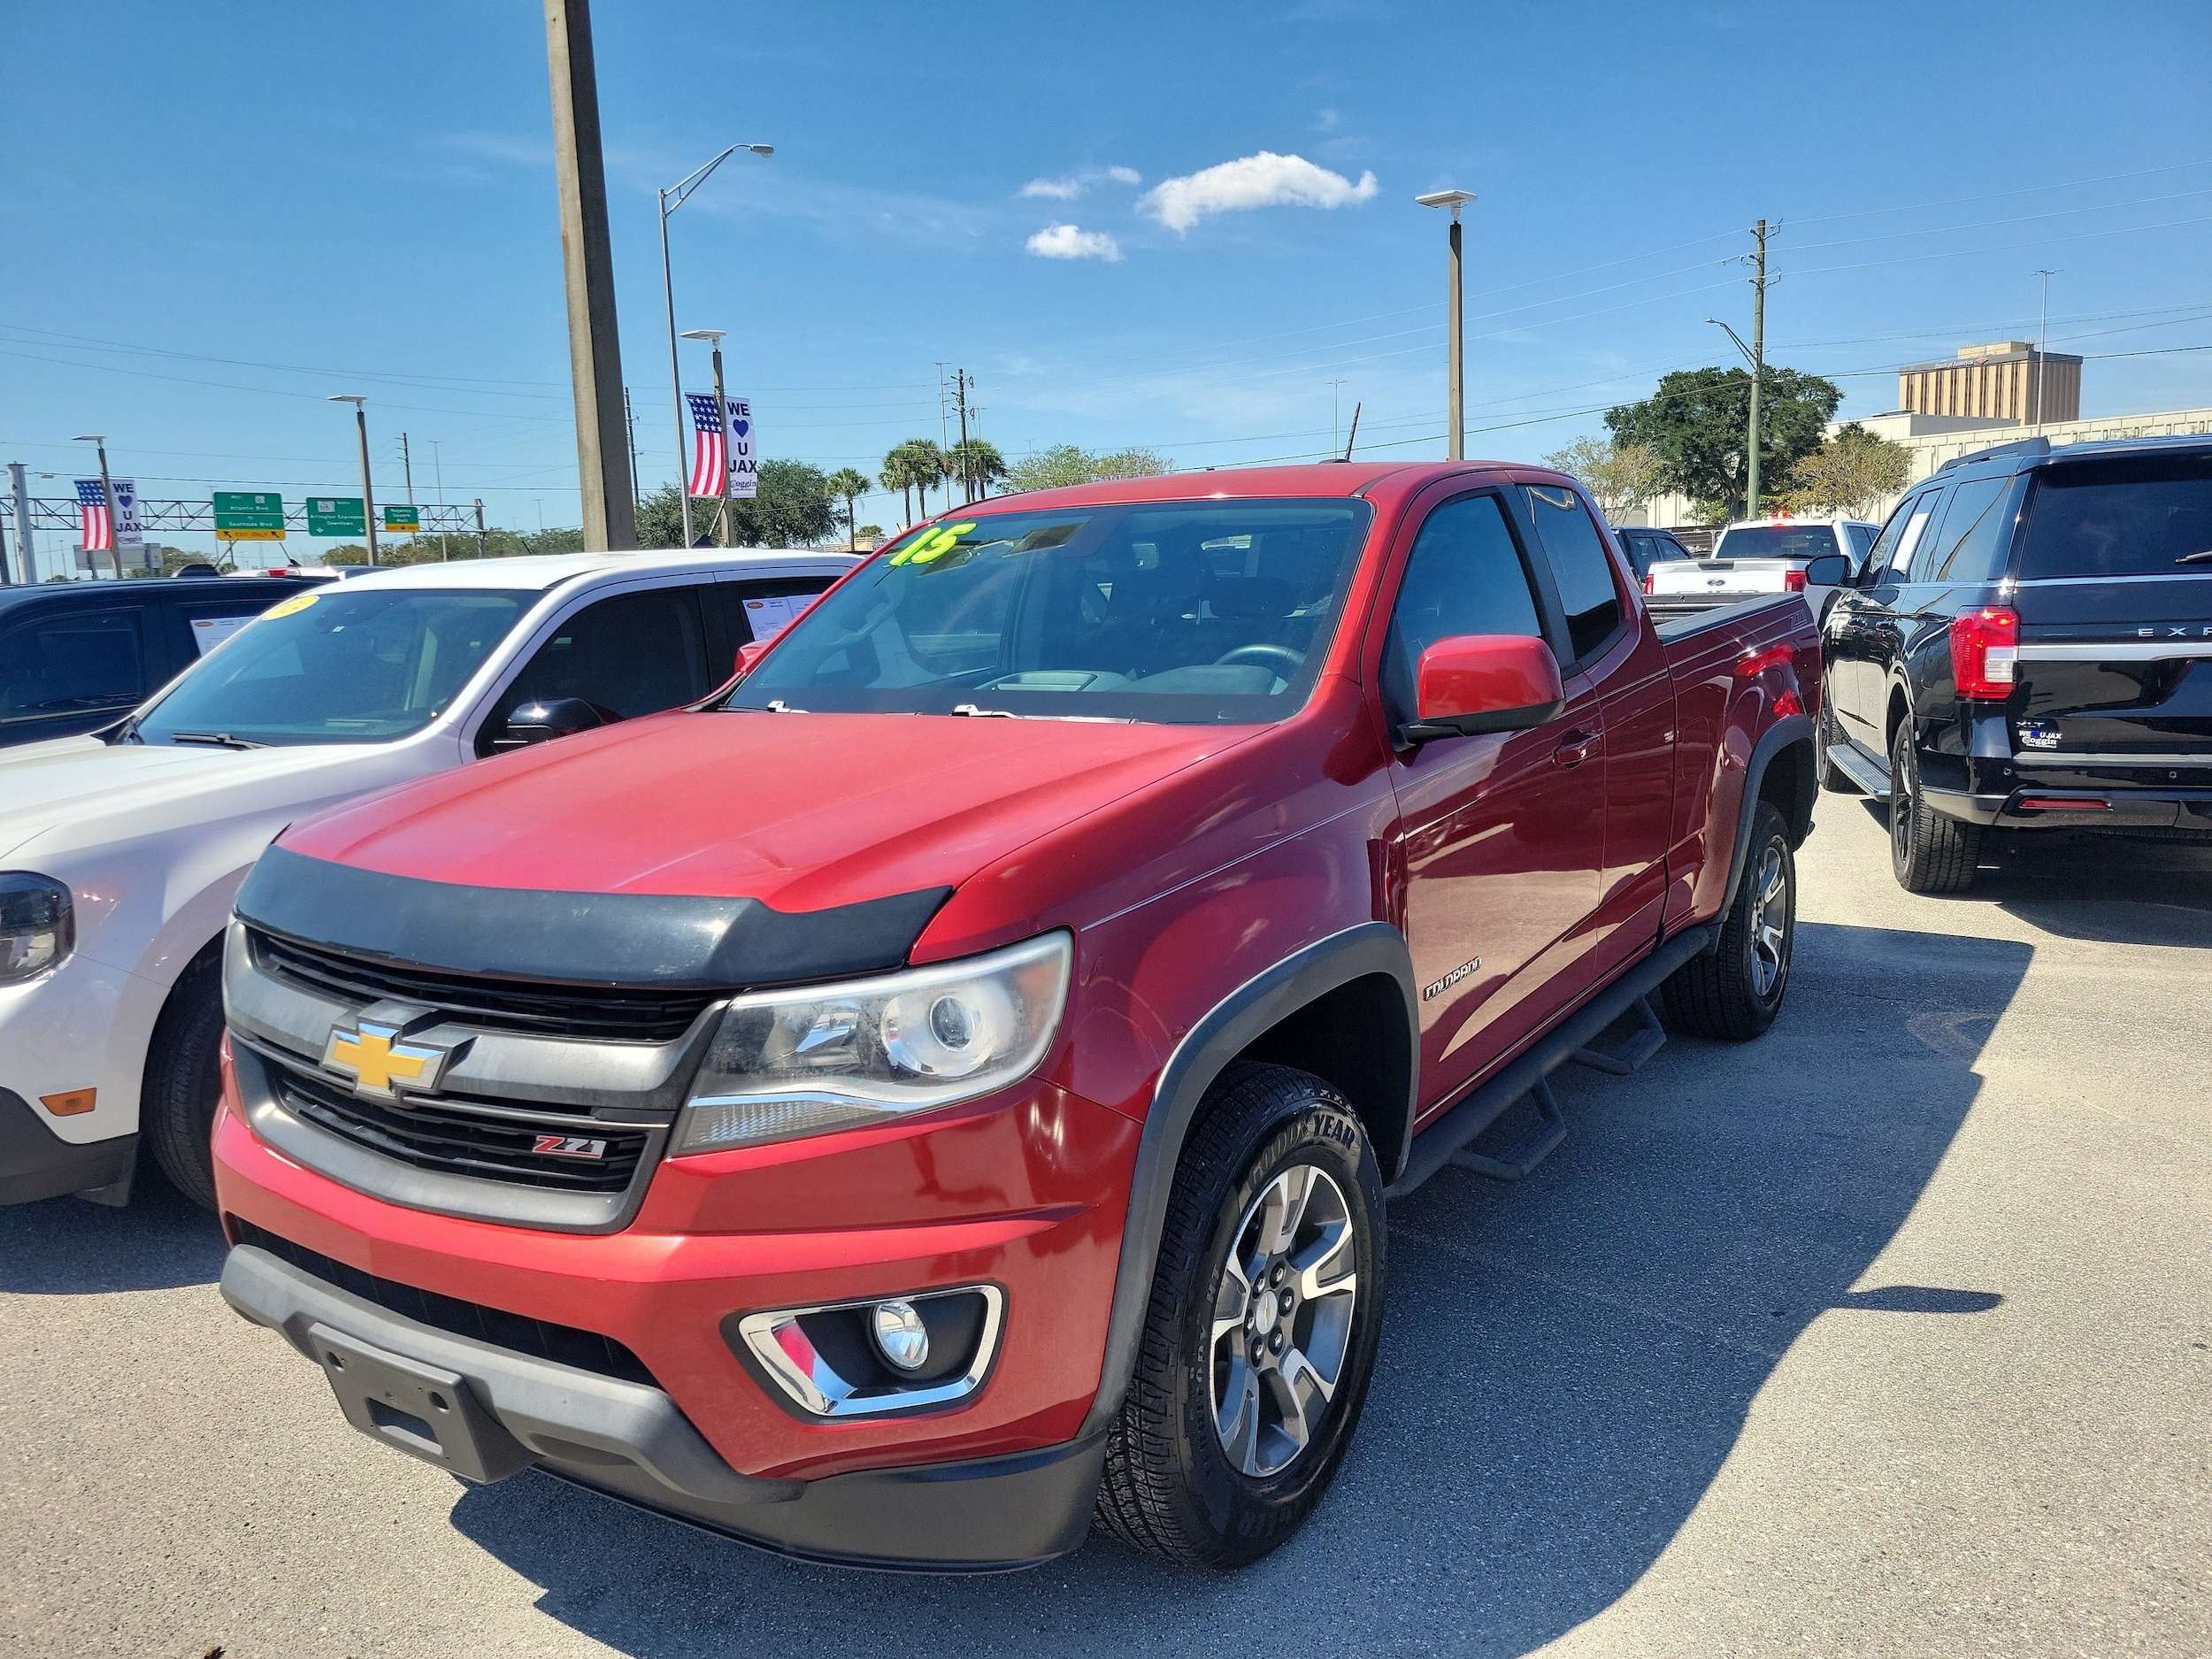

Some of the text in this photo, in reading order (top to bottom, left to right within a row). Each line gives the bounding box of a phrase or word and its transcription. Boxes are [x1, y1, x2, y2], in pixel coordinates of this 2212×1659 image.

[726, 402, 750, 417] WE
[737, 442, 749, 456] U
[729, 459, 758, 473] JAX
[112, 483, 134, 493] WE
[730, 479, 757, 488] Coggin
[123, 511, 132, 520] U
[116, 522, 142, 532] JAX
[888, 523, 977, 566] 15
[2021, 736, 2057, 746] Coggin
[533, 1135, 608, 1159] Z71
